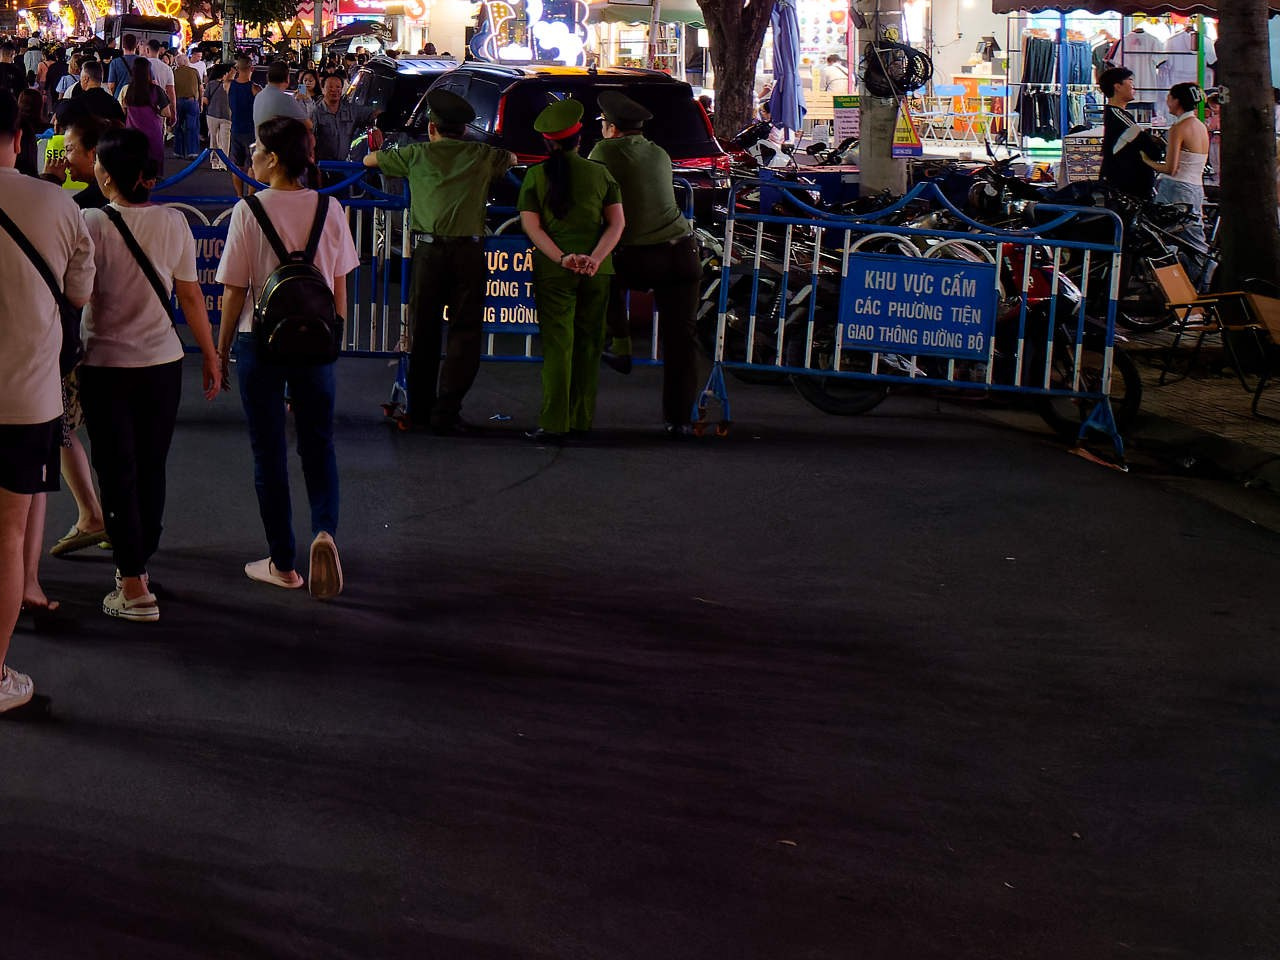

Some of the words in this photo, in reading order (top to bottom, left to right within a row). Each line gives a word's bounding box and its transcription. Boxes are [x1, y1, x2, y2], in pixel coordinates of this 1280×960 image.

[864, 269, 897, 291] KHU
[903, 272, 935, 297] VỰC
[941, 271, 976, 298] CẤM
[854, 296, 881, 315] CÁC
[888, 301, 943, 321] PHƯƠNG
[951, 305, 981, 326] TIỆN
[847, 323, 875, 340] GIAO
[879, 324, 918, 345] THÔNG
[922, 327, 963, 349] ĐƯỜNG
[967, 332, 984, 352] BỘ
